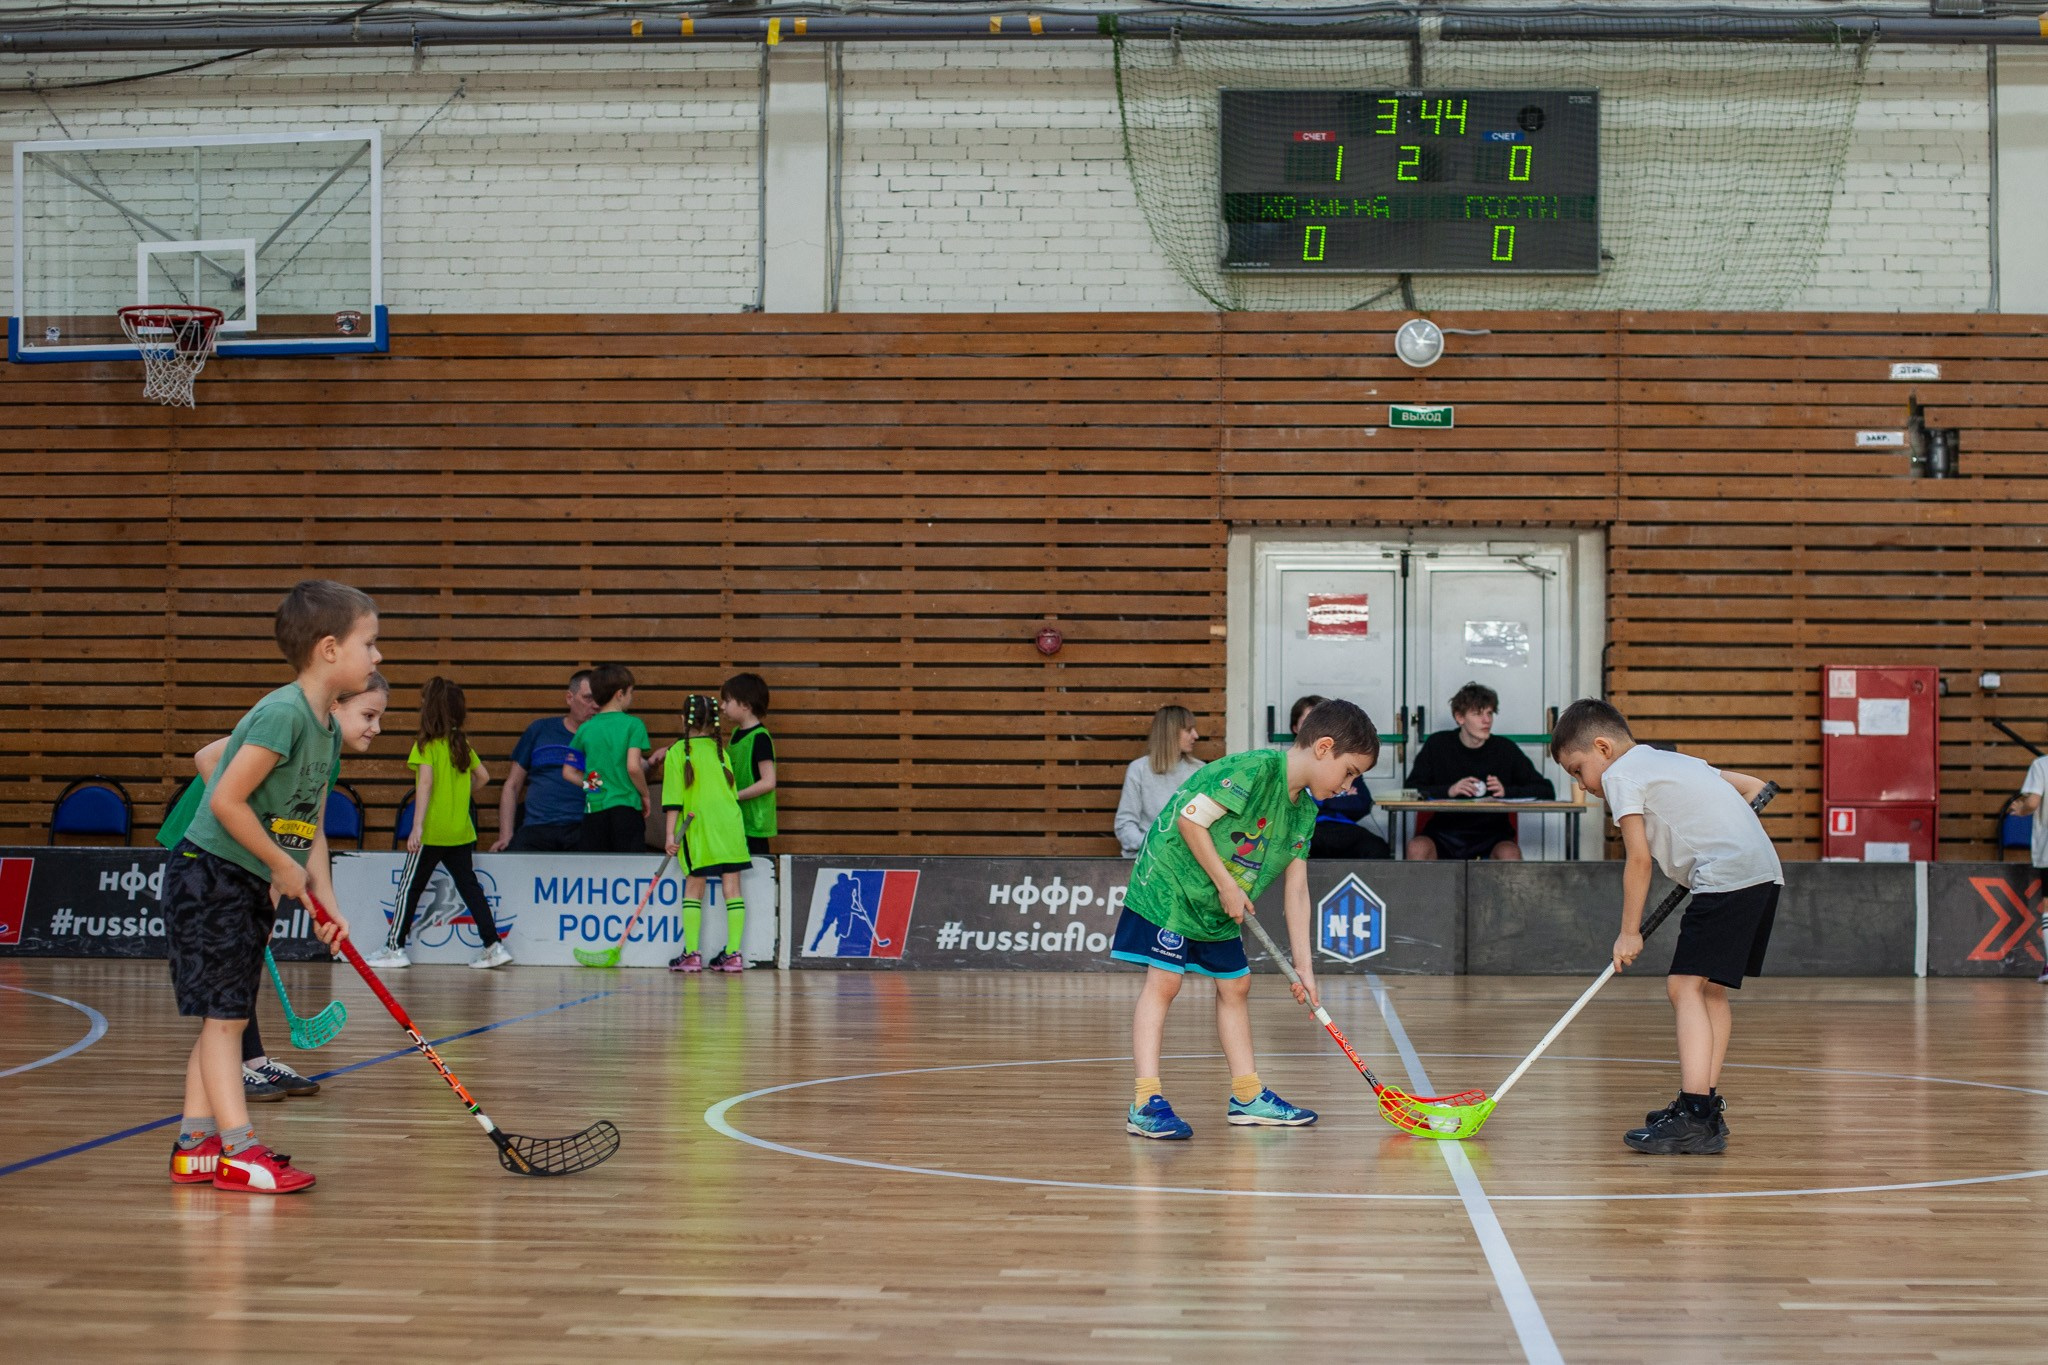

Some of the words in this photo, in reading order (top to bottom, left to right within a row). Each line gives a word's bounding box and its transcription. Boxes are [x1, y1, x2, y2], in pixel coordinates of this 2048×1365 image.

[1375, 99, 1468, 135] 3:44
[1302, 132, 1328, 141] СЧЕТ
[1491, 132, 1517, 141] СЧЕТ
[1334, 145, 1344, 182] 1
[1396, 145, 1421, 182] 2
[1508, 145, 1533, 182] 0
[1302, 225, 1327, 261] 0
[1491, 225, 1516, 261] 0
[1402, 412, 1441, 423] ВЫХОД
[534, 876, 723, 907] МИНСПОТ
[989, 876, 1127, 915] нффр.р
[936, 921, 1115, 953] #russiaflo
